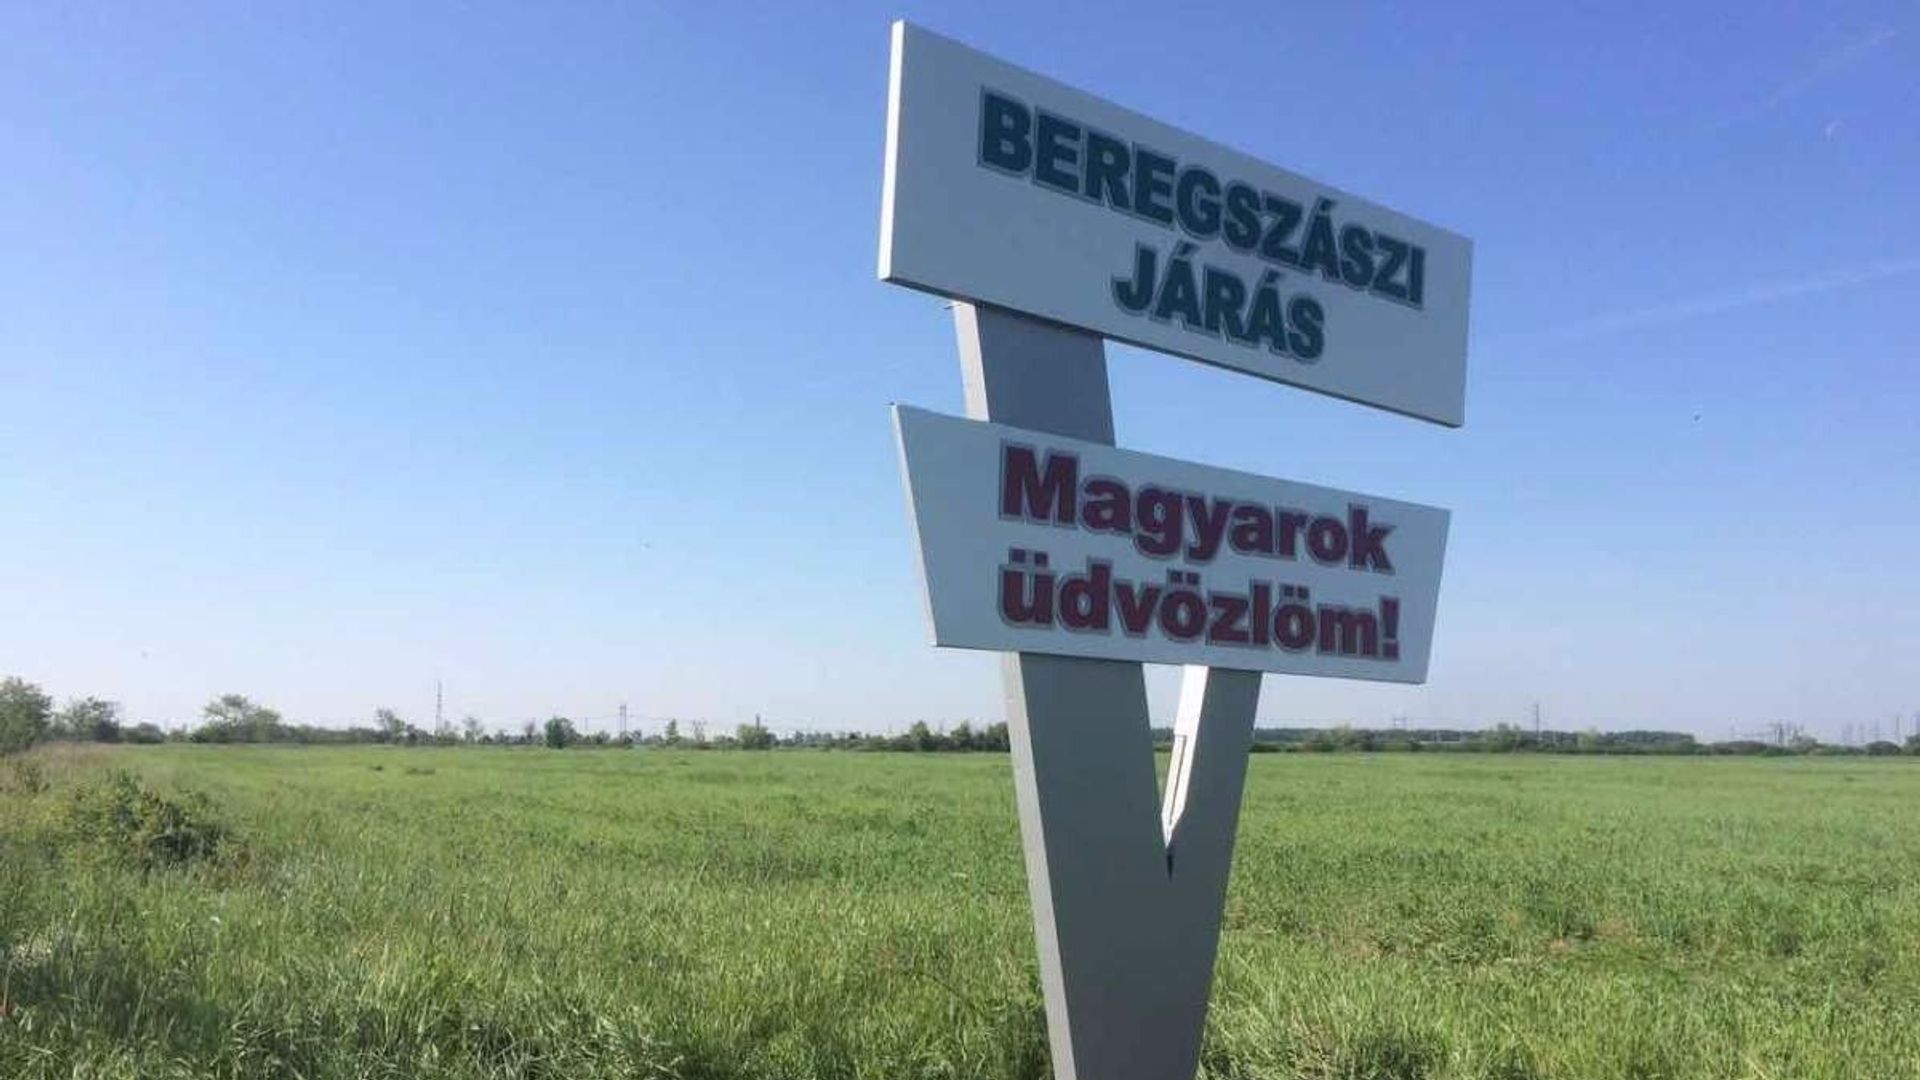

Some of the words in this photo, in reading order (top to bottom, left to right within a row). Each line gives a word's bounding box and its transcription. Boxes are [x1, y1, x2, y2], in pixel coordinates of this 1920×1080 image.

[977, 85, 1426, 310] BEREGSZÁSZI
[1111, 240, 1326, 365] JÁRÁS
[999, 438, 1397, 574] Magyarok
[998, 547, 1401, 662] üdvözlöm!
